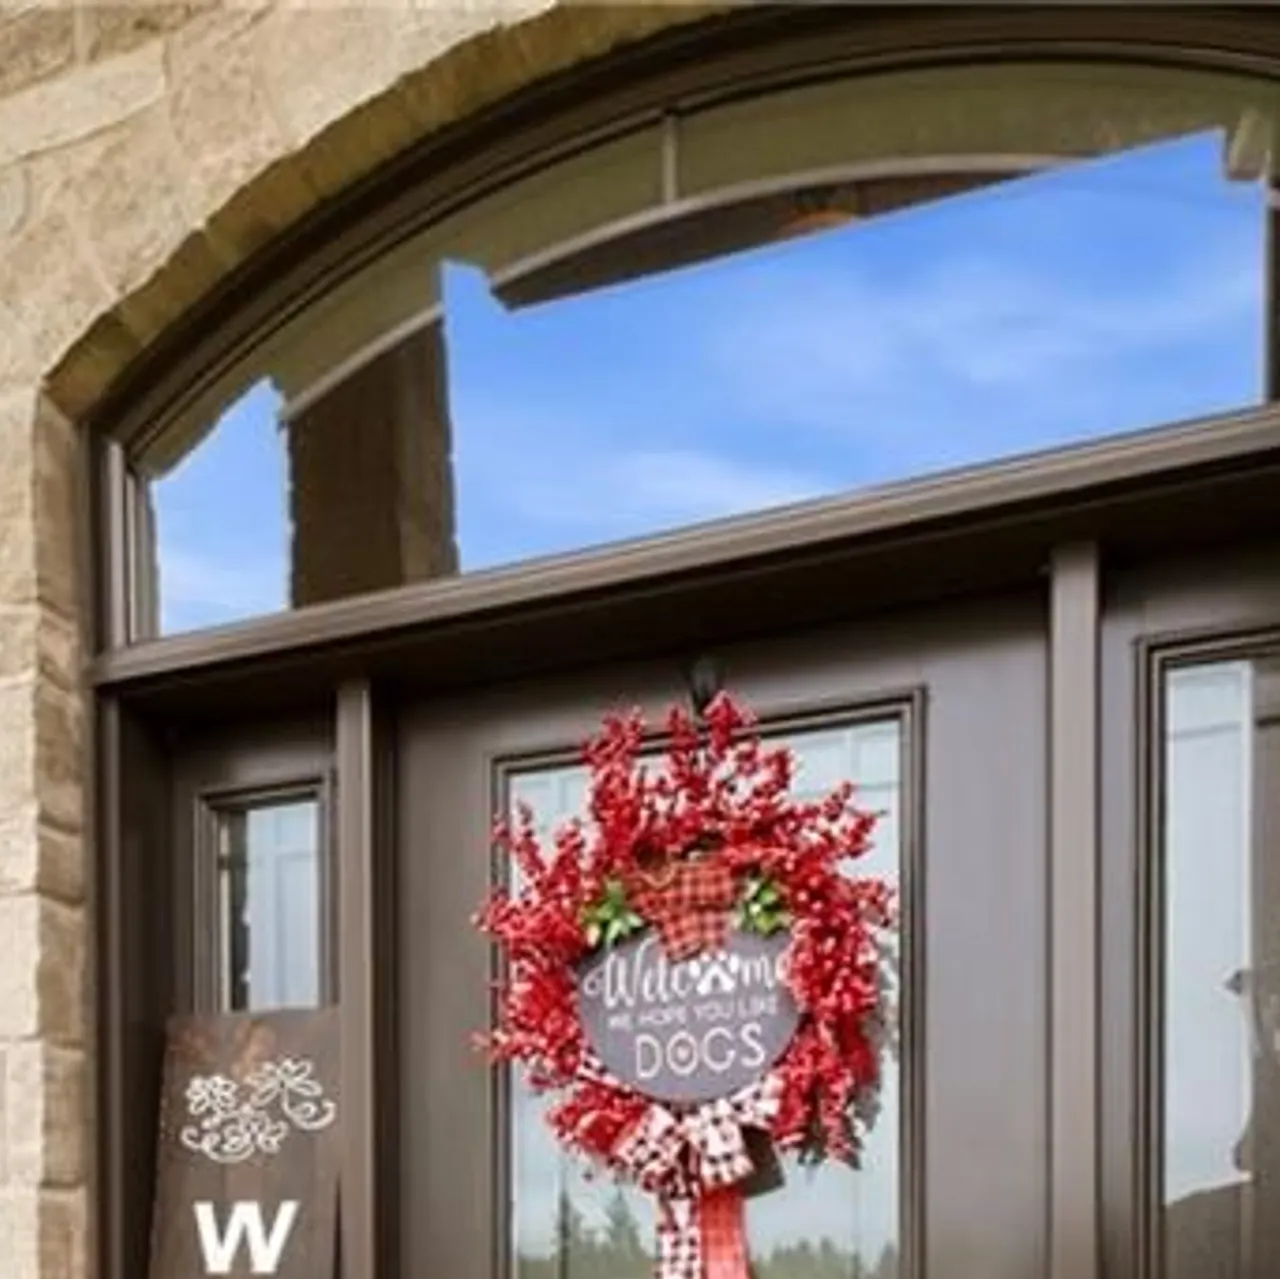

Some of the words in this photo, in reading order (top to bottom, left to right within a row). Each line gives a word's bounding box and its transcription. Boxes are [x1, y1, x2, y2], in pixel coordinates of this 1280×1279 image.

[639, 1004, 687, 1025] HOPE
[694, 1000, 733, 1020] YOU
[636, 1022, 765, 1078] DOGS
